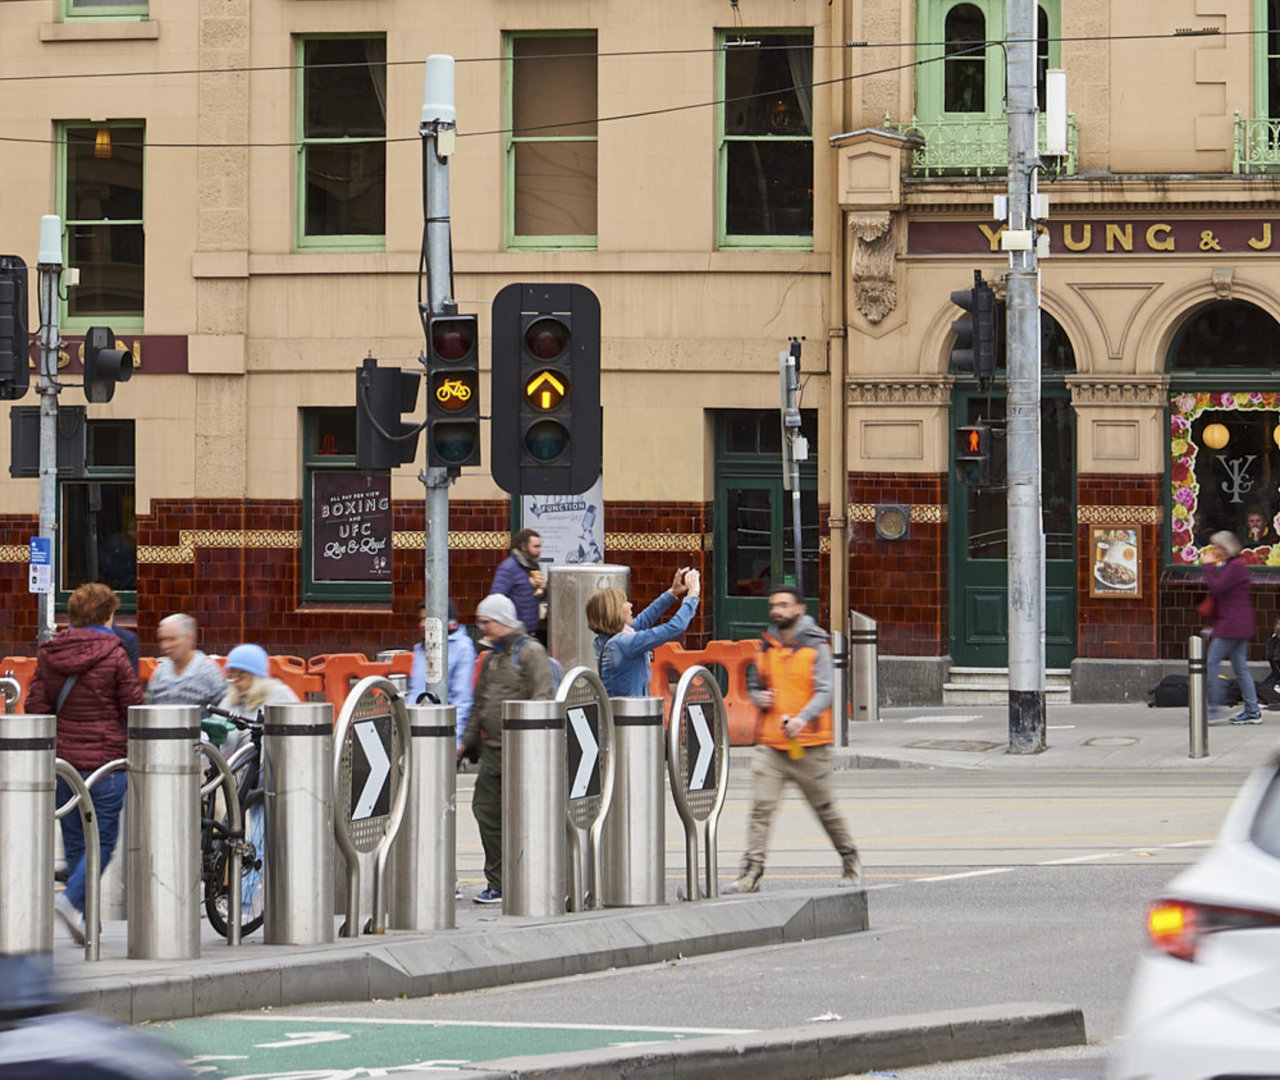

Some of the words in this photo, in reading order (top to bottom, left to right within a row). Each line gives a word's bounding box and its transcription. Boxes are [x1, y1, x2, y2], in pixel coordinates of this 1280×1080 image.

[978, 223, 1176, 252] YUNG
[1199, 229, 1222, 252] &
[321, 497, 389, 518] BOXING
[541, 502, 585, 512] FUNCTION
[339, 522, 371, 538] UFC
